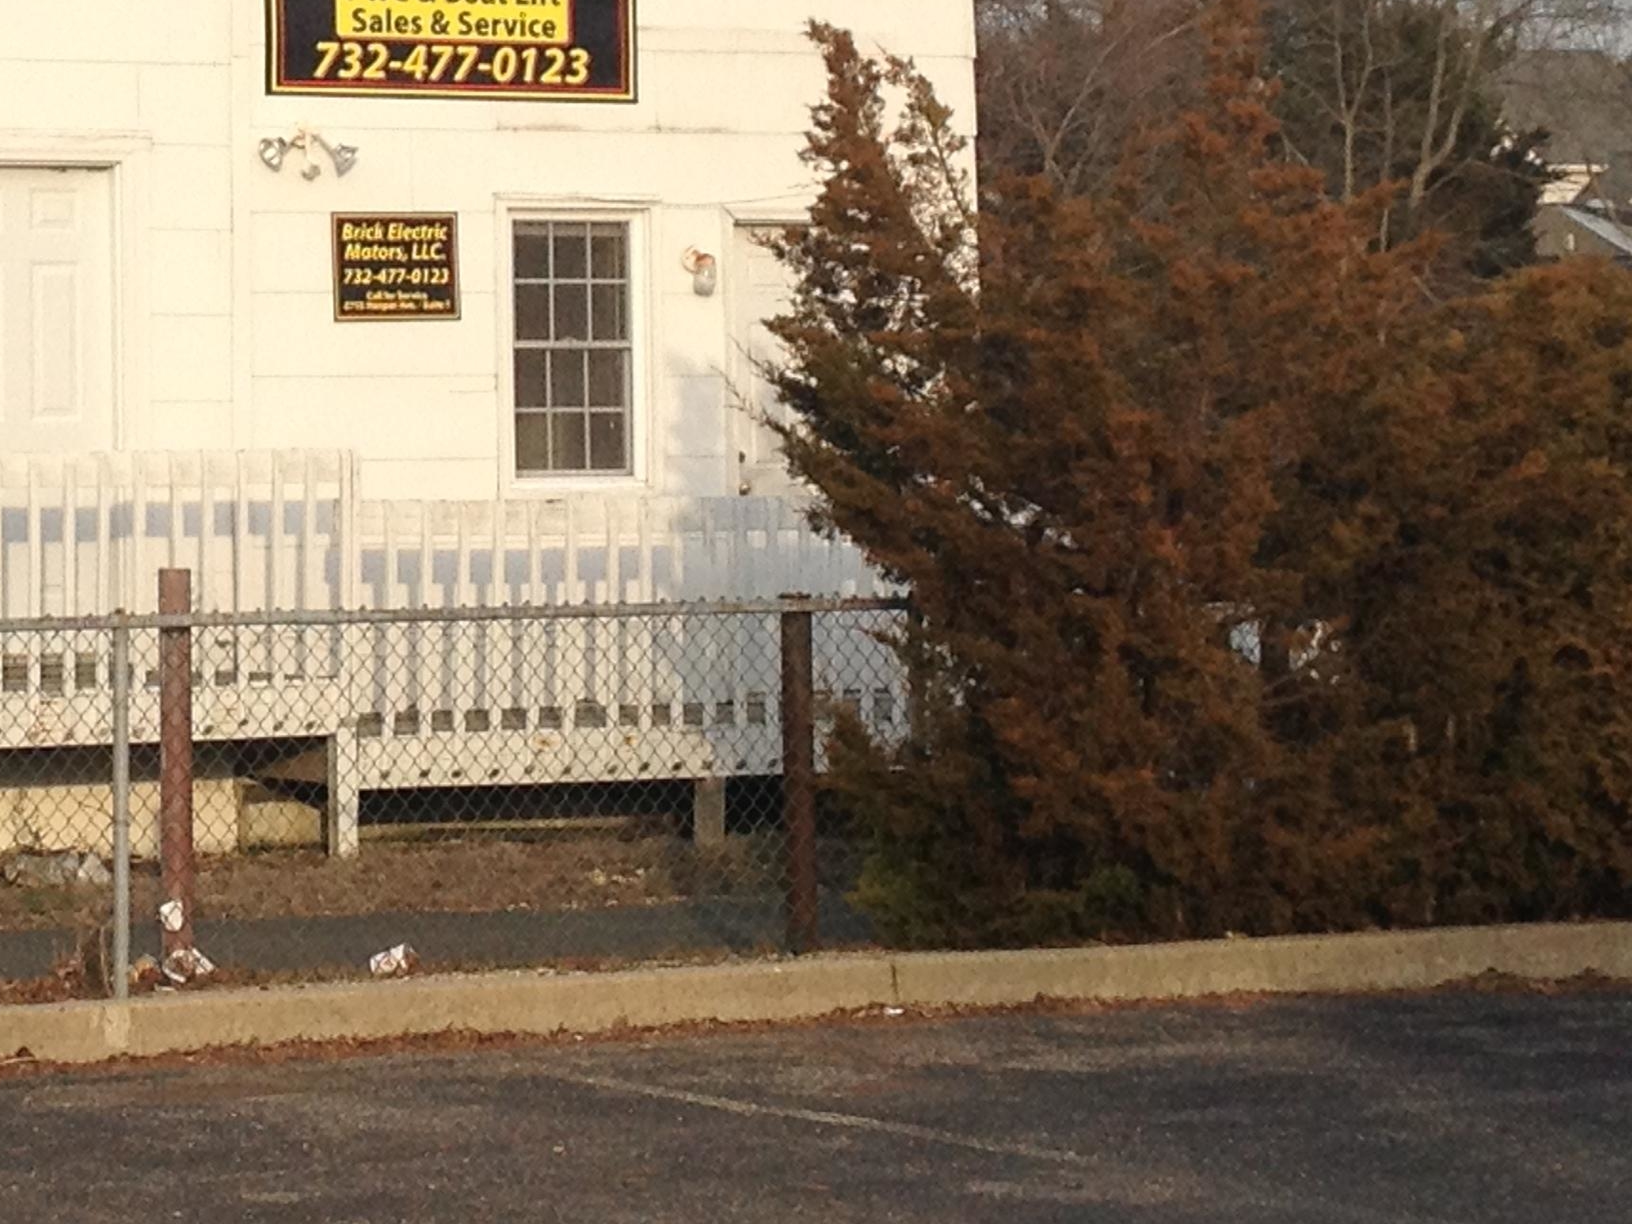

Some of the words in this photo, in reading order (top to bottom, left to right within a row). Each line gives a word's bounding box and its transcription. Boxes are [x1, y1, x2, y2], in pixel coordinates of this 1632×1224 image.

[352, 8, 422, 34] Sales
[430, 12, 450, 35] &
[458, 12, 557, 37] Service
[313, 42, 589, 83] 732-477-0123
[342, 223, 383, 240] Brick
[387, 223, 448, 241] Electric
[343, 268, 449, 284] 732-477-0123
